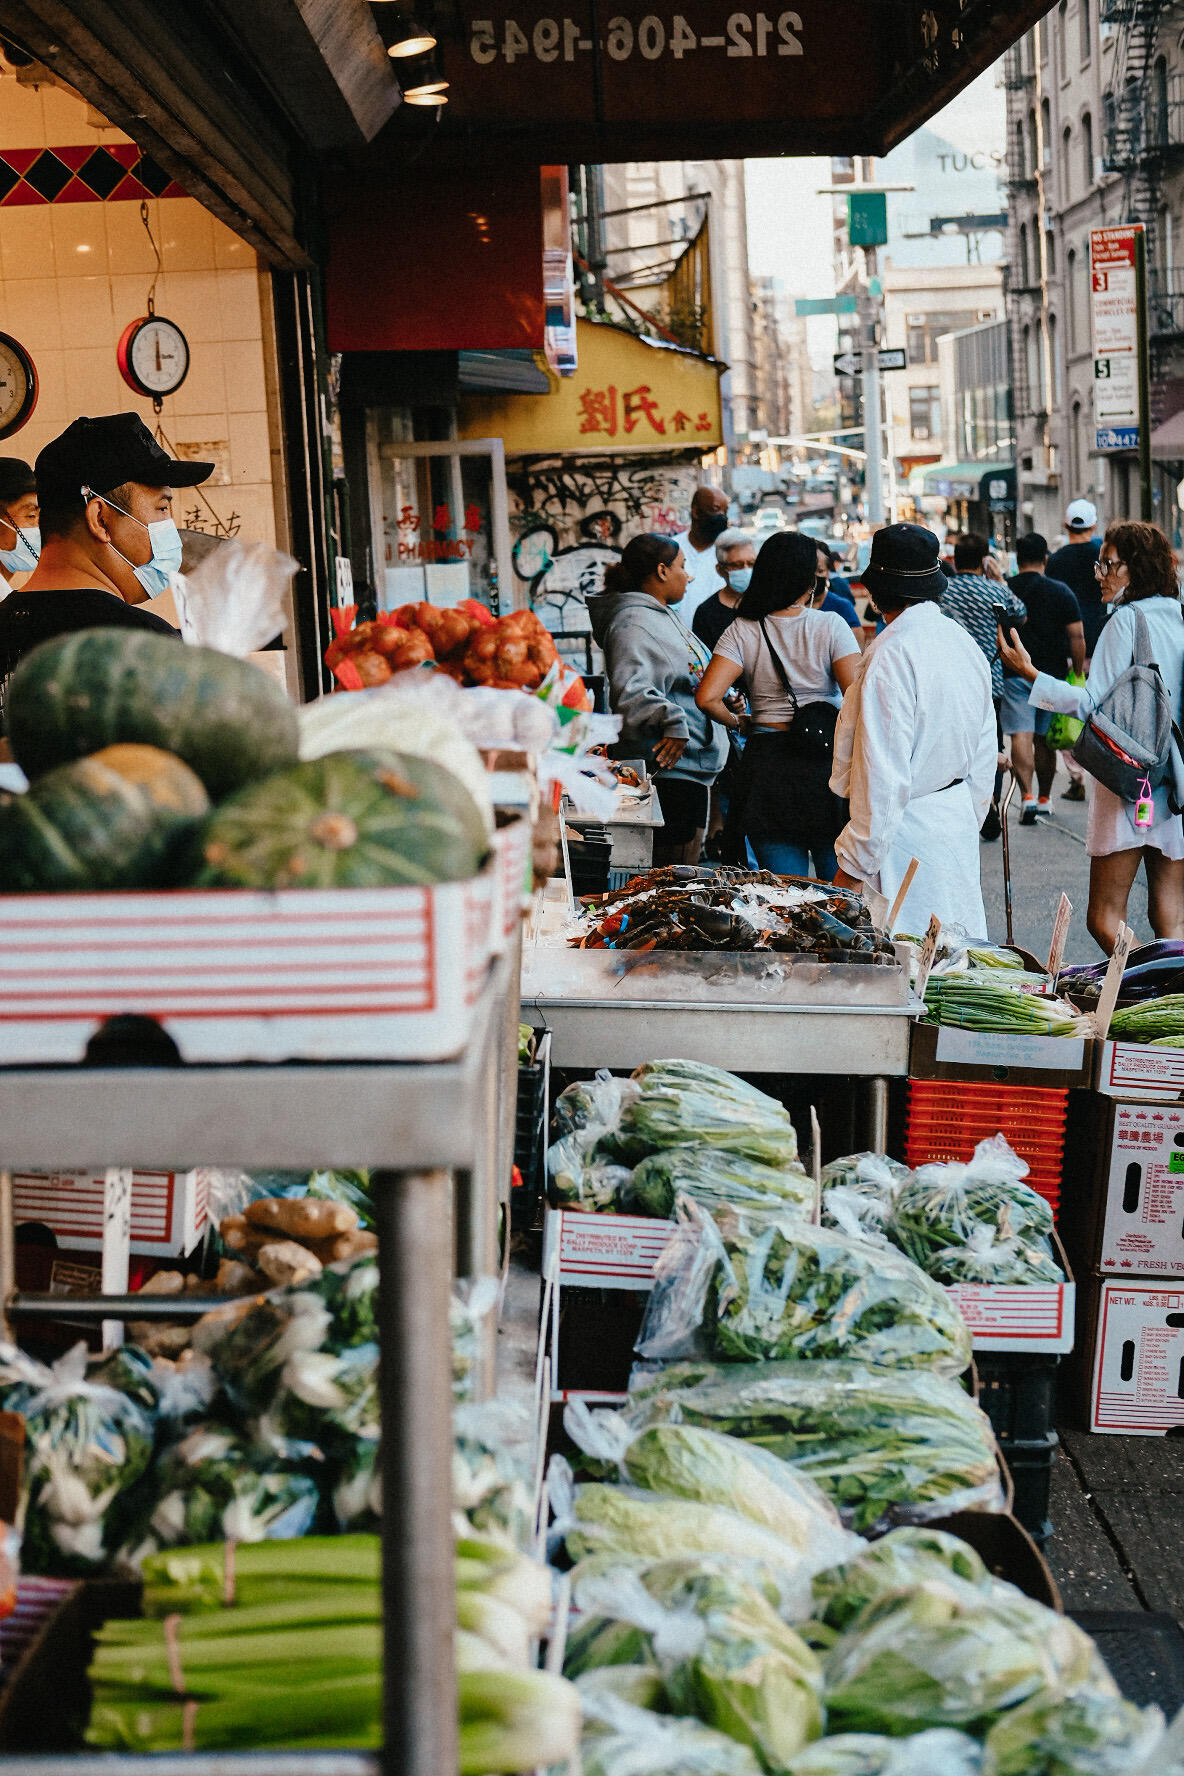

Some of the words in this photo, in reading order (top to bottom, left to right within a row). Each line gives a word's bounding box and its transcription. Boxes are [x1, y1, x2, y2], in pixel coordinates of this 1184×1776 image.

[1097, 271, 1106, 290] 3
[1098, 360, 1107, 377] 5
[398, 539, 474, 561] PHARMACY
[1137, 1260, 1168, 1270] FRESH
[1110, 1296, 1123, 1304] NET
